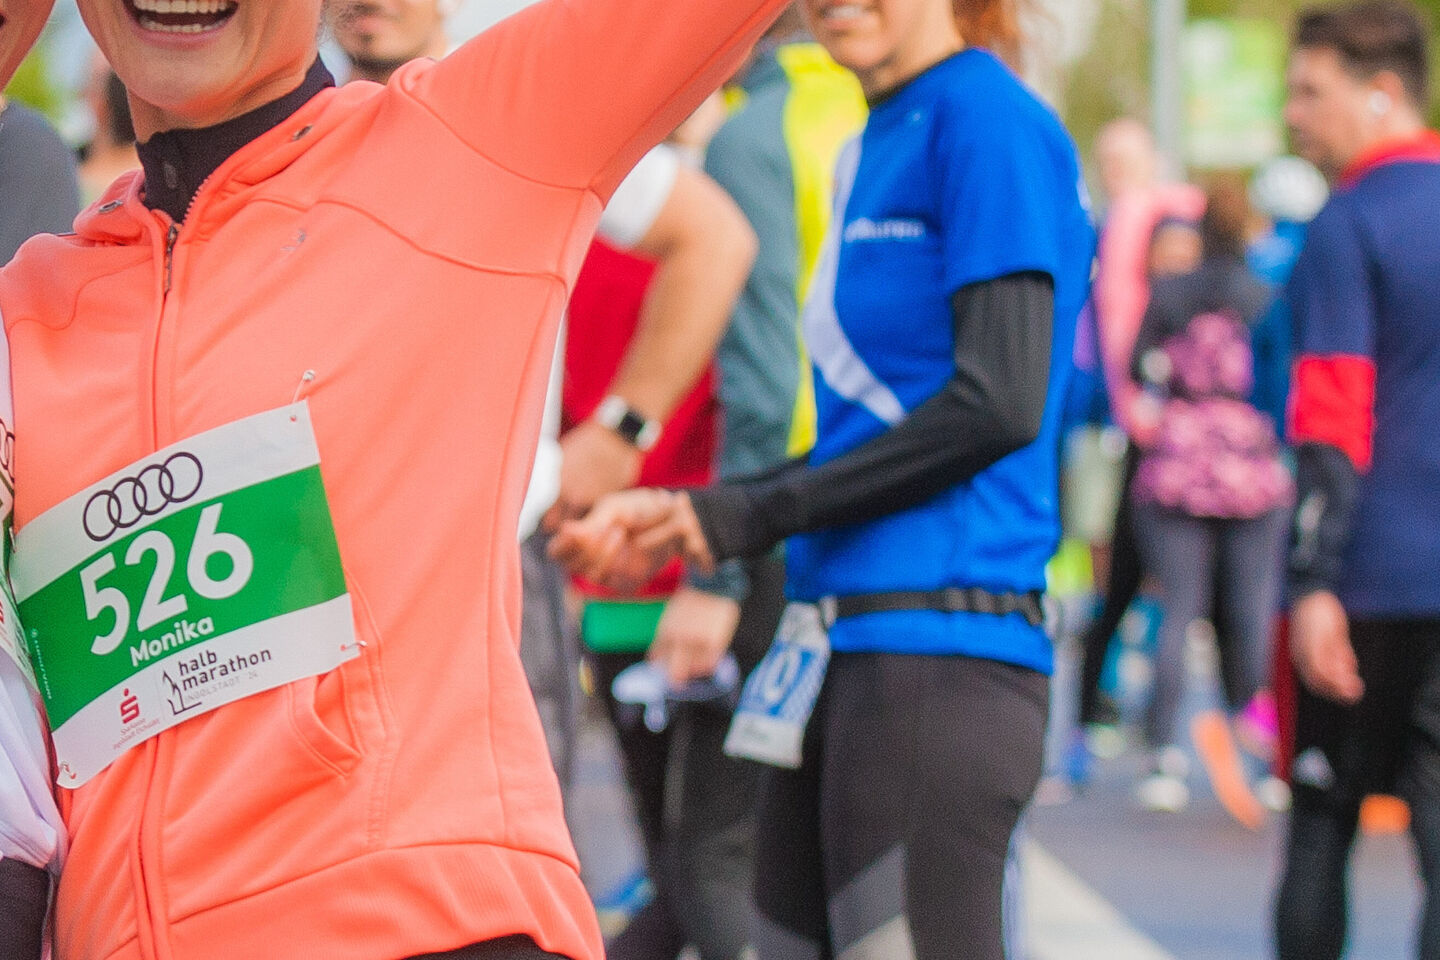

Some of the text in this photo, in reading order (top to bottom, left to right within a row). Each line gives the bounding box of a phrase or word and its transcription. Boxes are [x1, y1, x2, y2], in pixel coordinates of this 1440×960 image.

[79, 502, 254, 656] 526
[130, 616, 215, 667] Monika
[178, 649, 218, 676] halb
[181, 648, 273, 691] marathon
